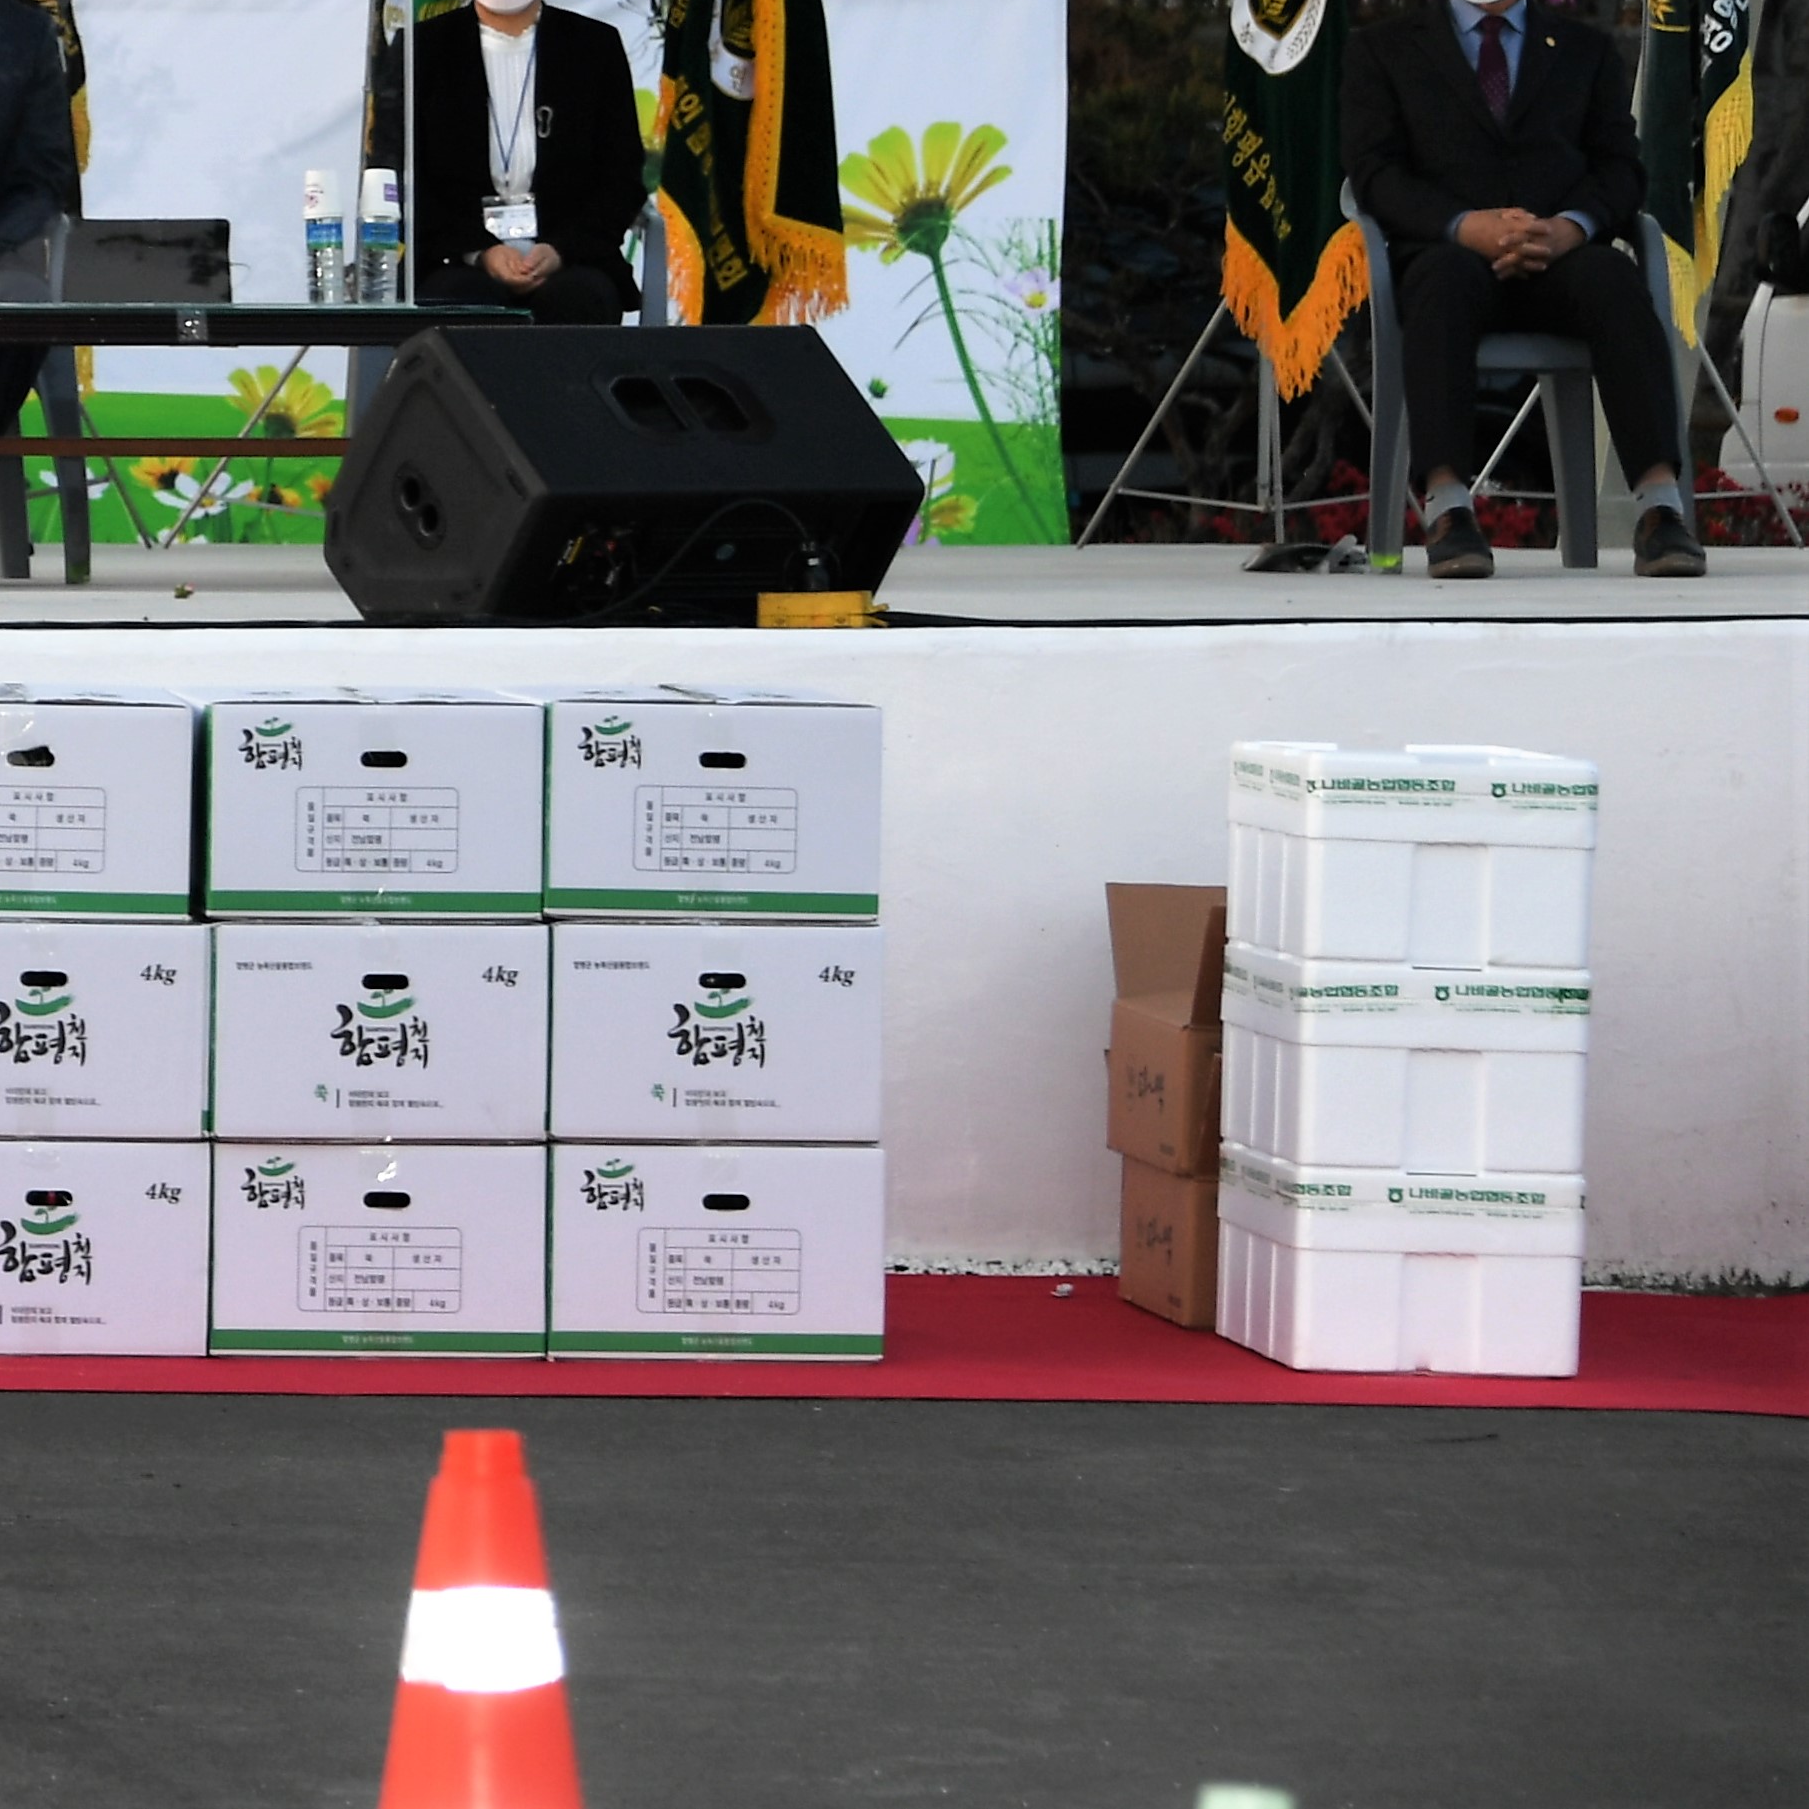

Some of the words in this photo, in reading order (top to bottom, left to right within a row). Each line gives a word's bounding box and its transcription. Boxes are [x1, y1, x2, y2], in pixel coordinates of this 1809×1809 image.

[141, 965, 178, 986] 4kg
[482, 966, 519, 987] 4kg
[819, 966, 856, 987] 4kg
[145, 1182, 182, 1203] 4kg
